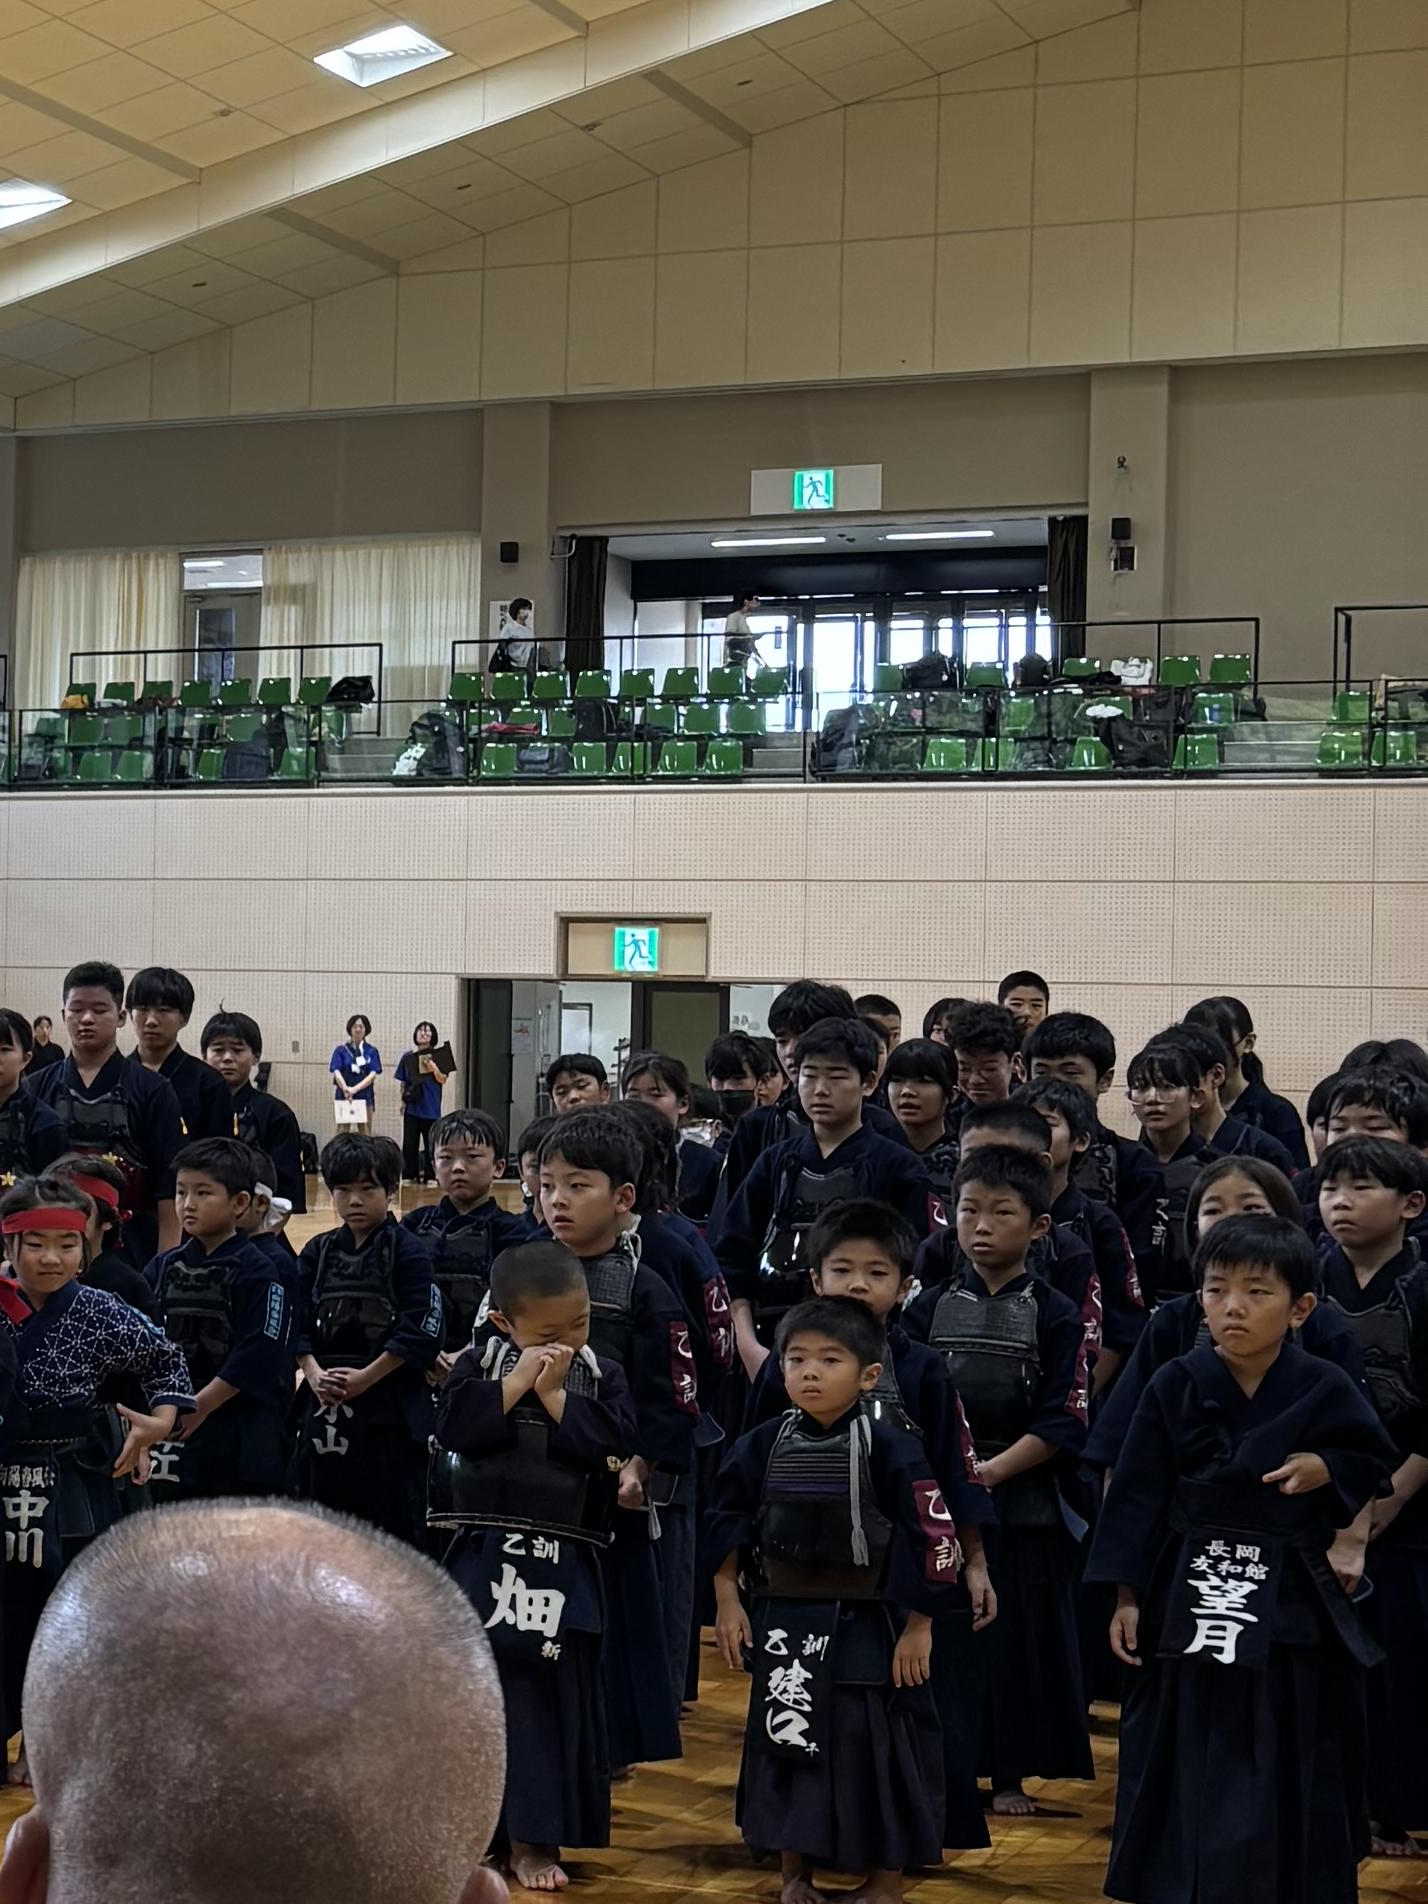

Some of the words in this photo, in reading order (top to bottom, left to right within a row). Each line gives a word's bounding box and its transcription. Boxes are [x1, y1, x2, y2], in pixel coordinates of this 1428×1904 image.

[148, 1441, 185, 1483] 江
[2, 1489, 50, 1569] 中川
[502, 1533, 559, 1564] 乙訓
[1205, 1540, 1261, 1562] 長岡
[1190, 1555, 1269, 1580] 友和館
[483, 1563, 565, 1637] 畑
[1183, 1574, 1259, 1664] 望月
[764, 1629, 829, 1661] 乙訓
